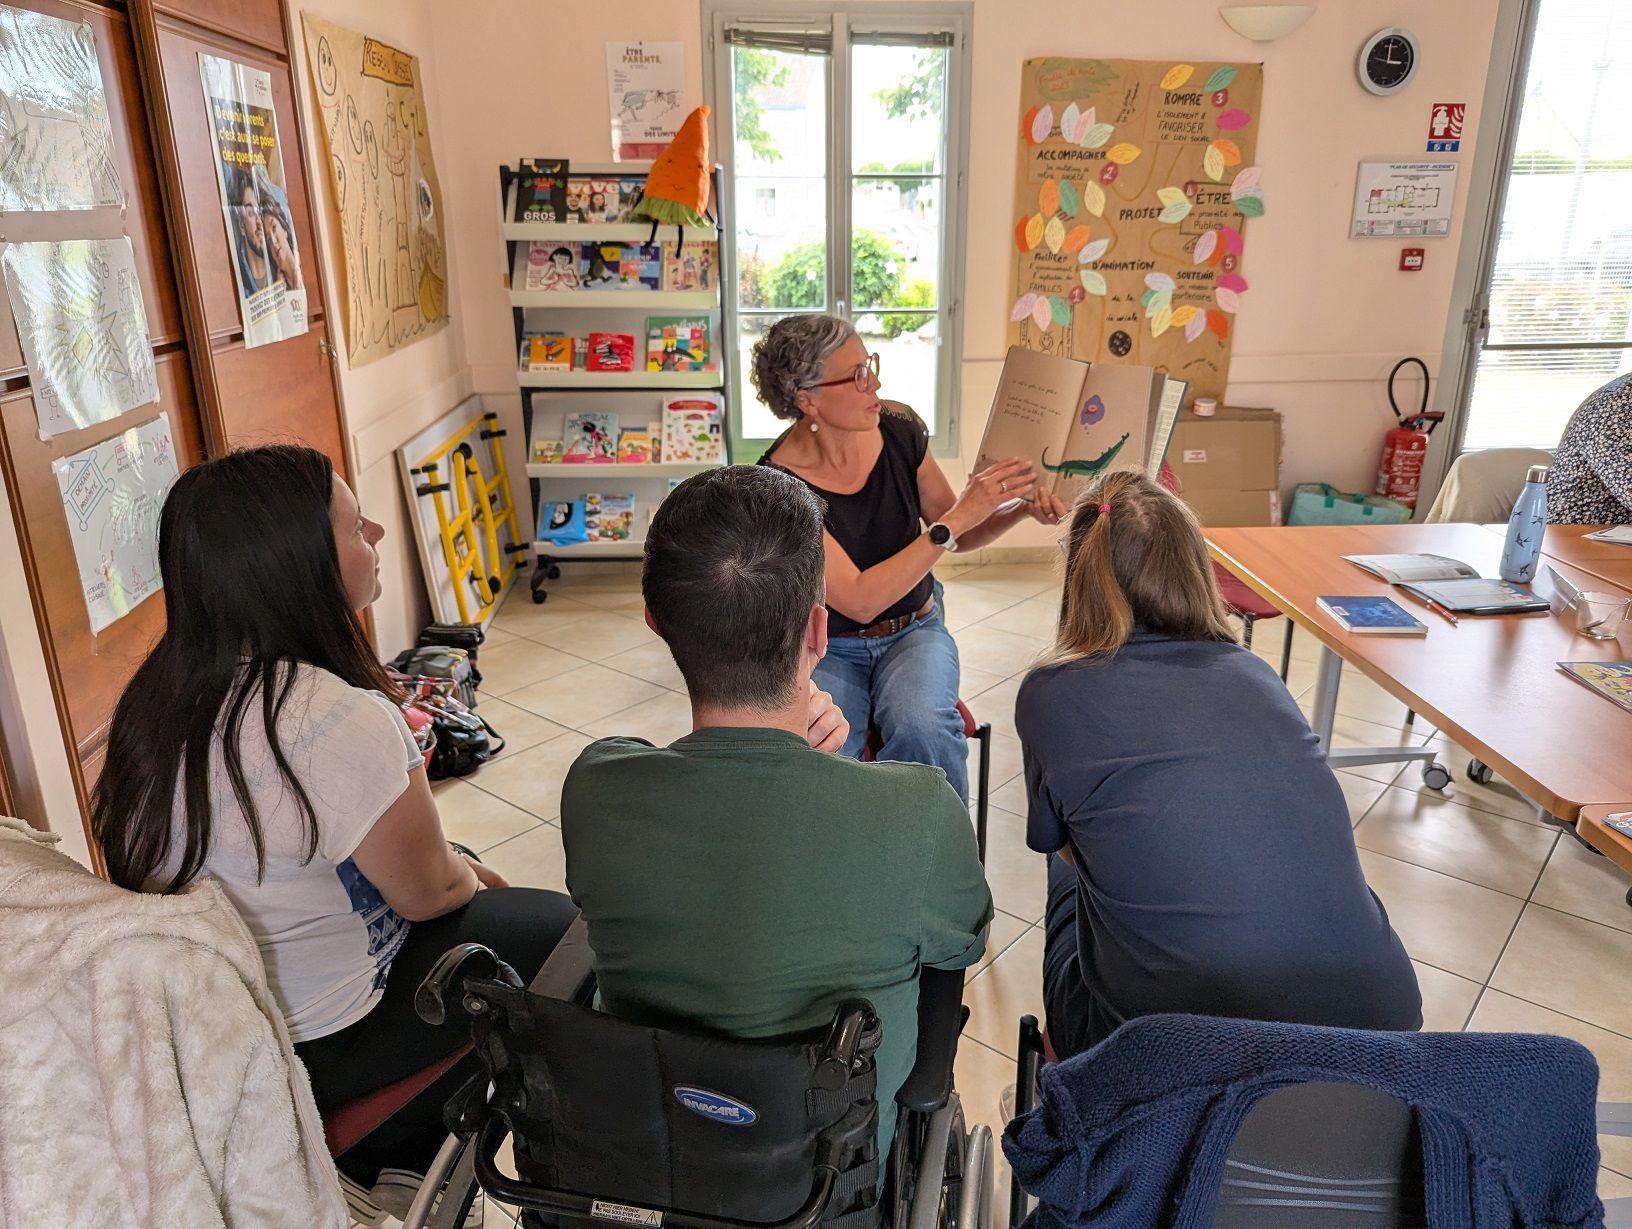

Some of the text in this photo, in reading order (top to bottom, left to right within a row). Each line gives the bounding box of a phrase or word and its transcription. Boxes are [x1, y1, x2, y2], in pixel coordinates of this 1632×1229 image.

[1163, 92, 1203, 106] ROMPRE
[1215, 92, 1224, 104] 3
[1158, 120, 1205, 133] FAVORISER
[1036, 150, 1107, 161] ACCOMPAGNER
[1103, 166, 1115, 180] 2
[524, 211, 556, 220] GROS
[1092, 259, 1155, 271] D'ANIMATION
[1226, 257, 1233, 269] 5
[1176, 272, 1214, 281] SOUTENIR
[1029, 283, 1063, 293] FAMILLES
[683, 1097, 740, 1117] INVACARE
